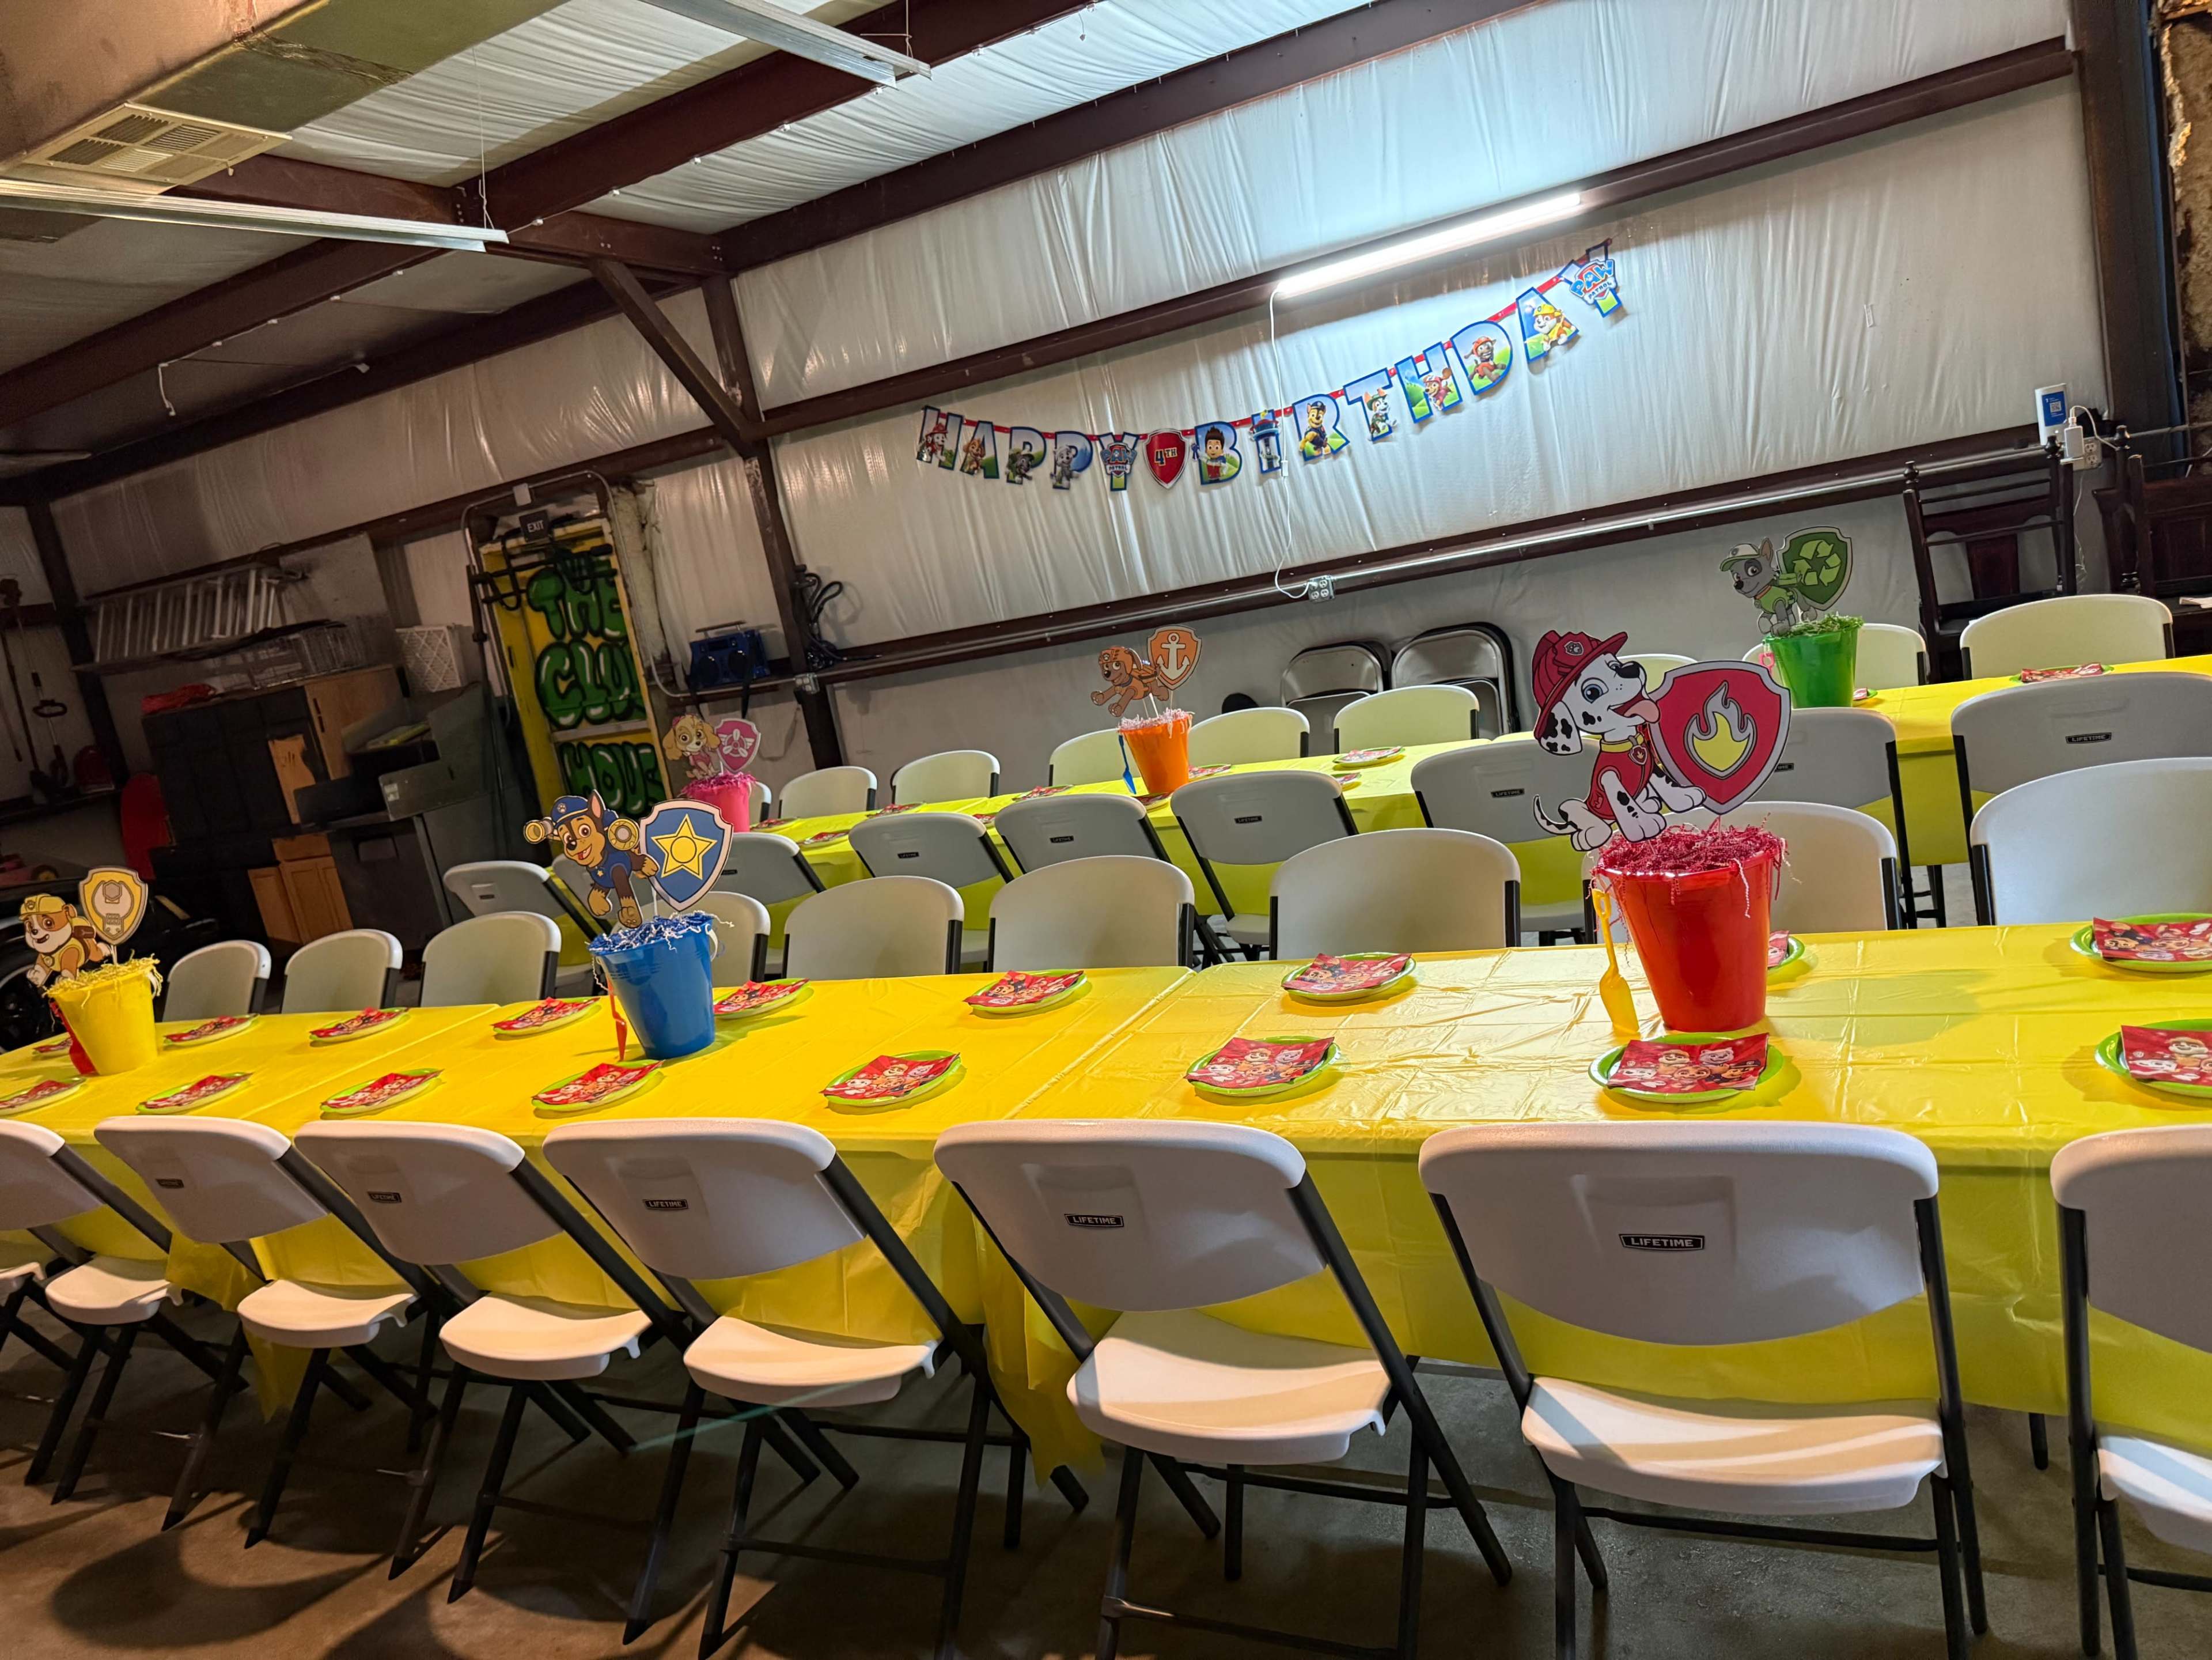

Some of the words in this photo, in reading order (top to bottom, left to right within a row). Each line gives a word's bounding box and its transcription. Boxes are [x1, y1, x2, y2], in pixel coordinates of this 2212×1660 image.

[1570, 259, 1613, 297] PAW
[1588, 281, 1612, 300] PATROL
[916, 405, 1139, 491] HAPPY
[1154, 447, 1177, 466] 4TH
[527, 520, 544, 532] EXIT
[2071, 734, 2106, 742] LIFETIME
[1072, 1216, 1116, 1224] LIFETIME
[1631, 1238, 1694, 1247] LIFETIME
